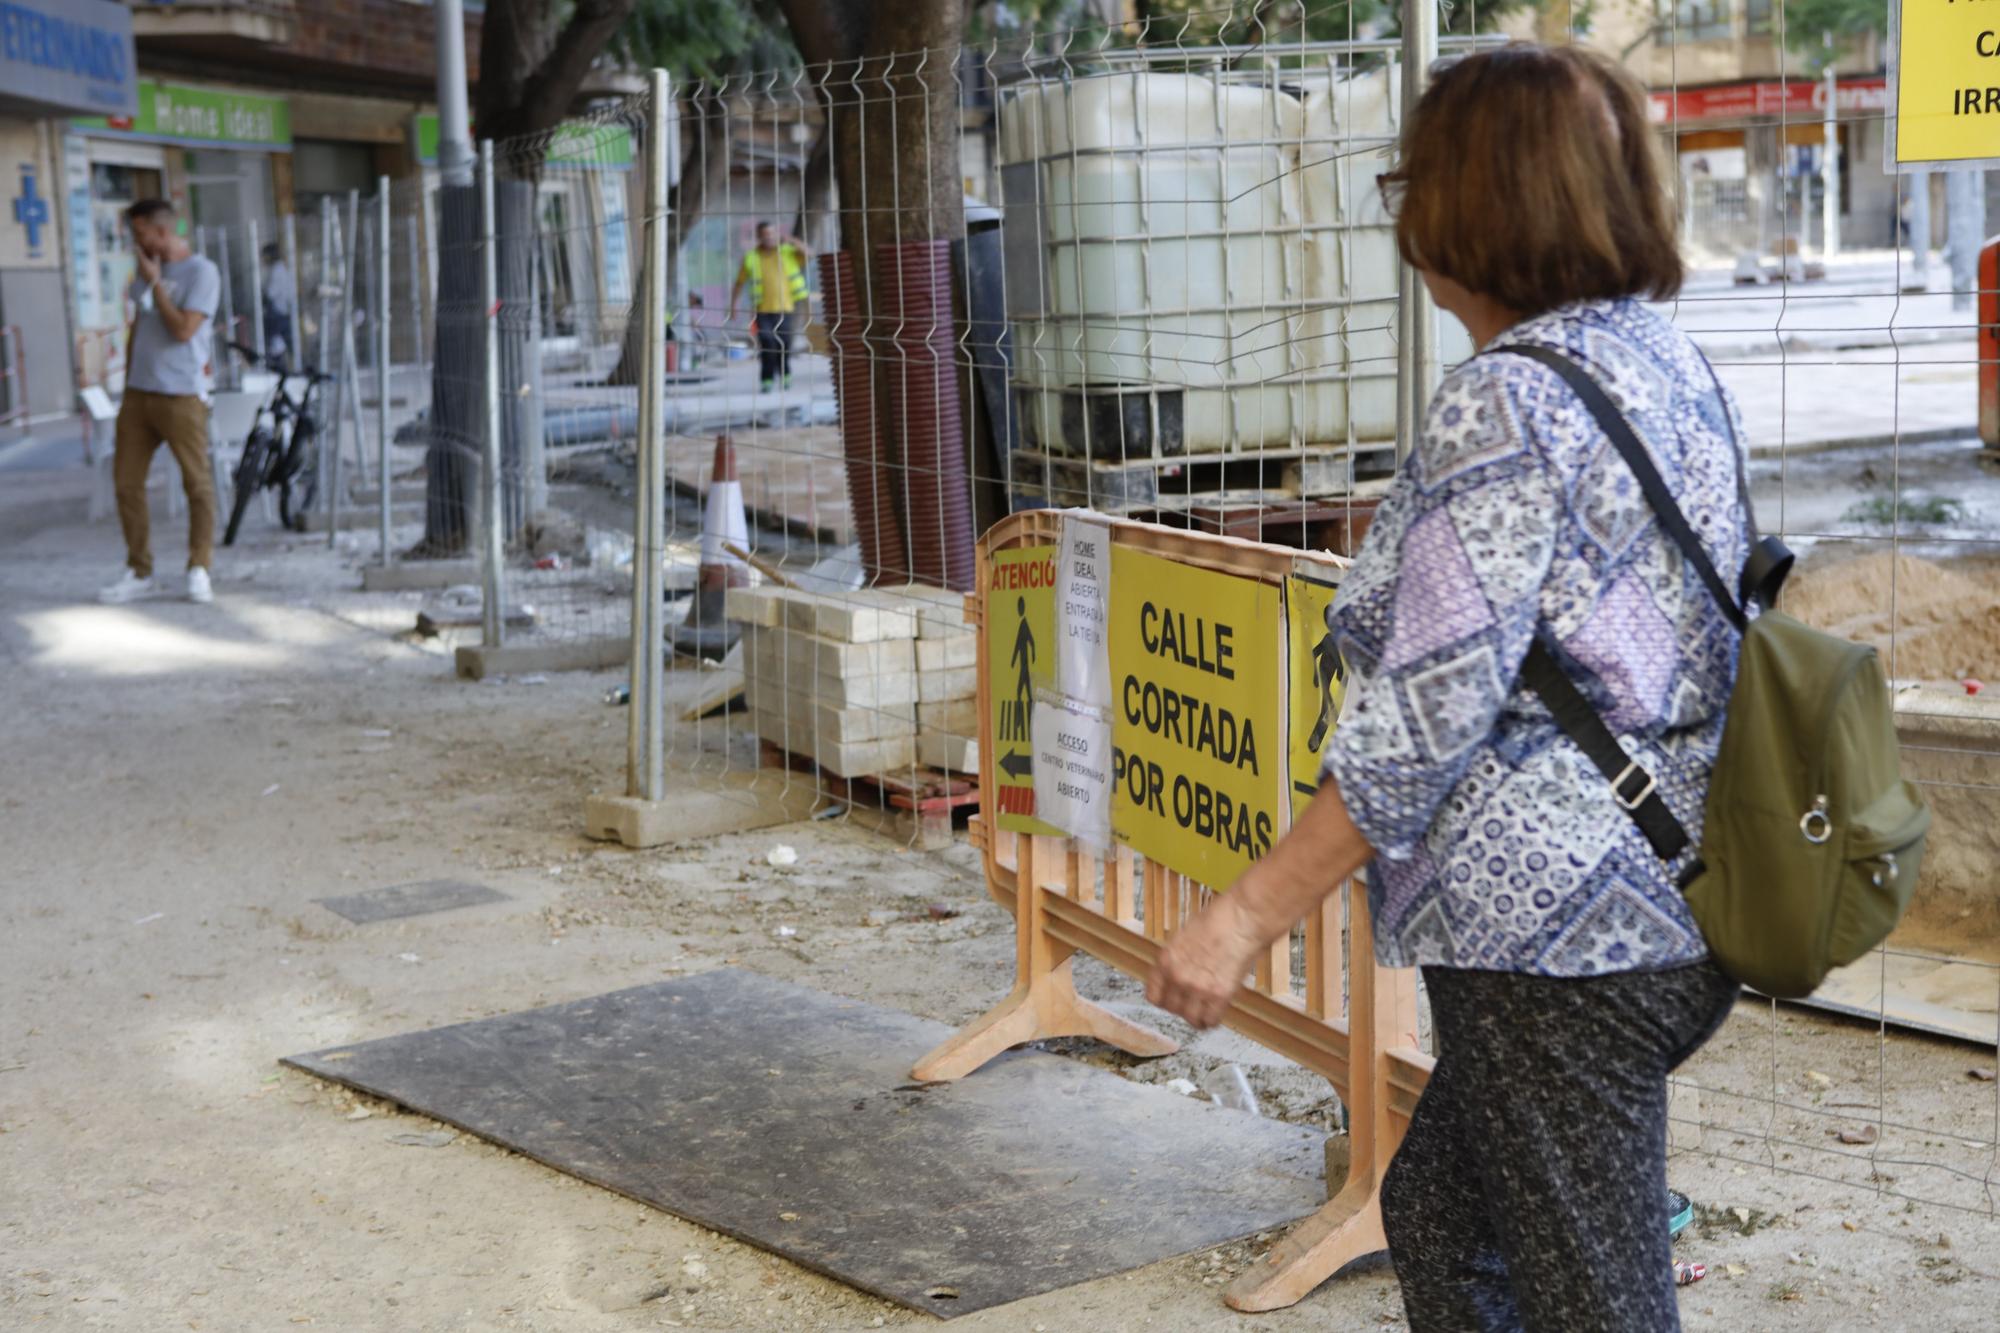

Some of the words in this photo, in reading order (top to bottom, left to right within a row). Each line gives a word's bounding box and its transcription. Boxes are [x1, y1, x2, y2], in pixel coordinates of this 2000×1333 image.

[1976, 30, 2000, 58] C
[154, 92, 219, 136] Home
[224, 100, 273, 140] ideal
[1074, 541, 1096, 557] HOME
[1074, 561, 1096, 578] IDEAL
[1068, 623, 1080, 638] LA
[1140, 600, 1235, 681] CALLE
[1123, 674, 1259, 777] CORTADA
[1057, 732, 1088, 752] ACCESO
[1041, 752, 1063, 769] CENTRO
[1065, 760, 1105, 784] VETERINARIO
[1057, 781, 1090, 804] ABIERTO
[1111, 745, 1166, 818] POR
[1172, 774, 1272, 861] OBRAS
